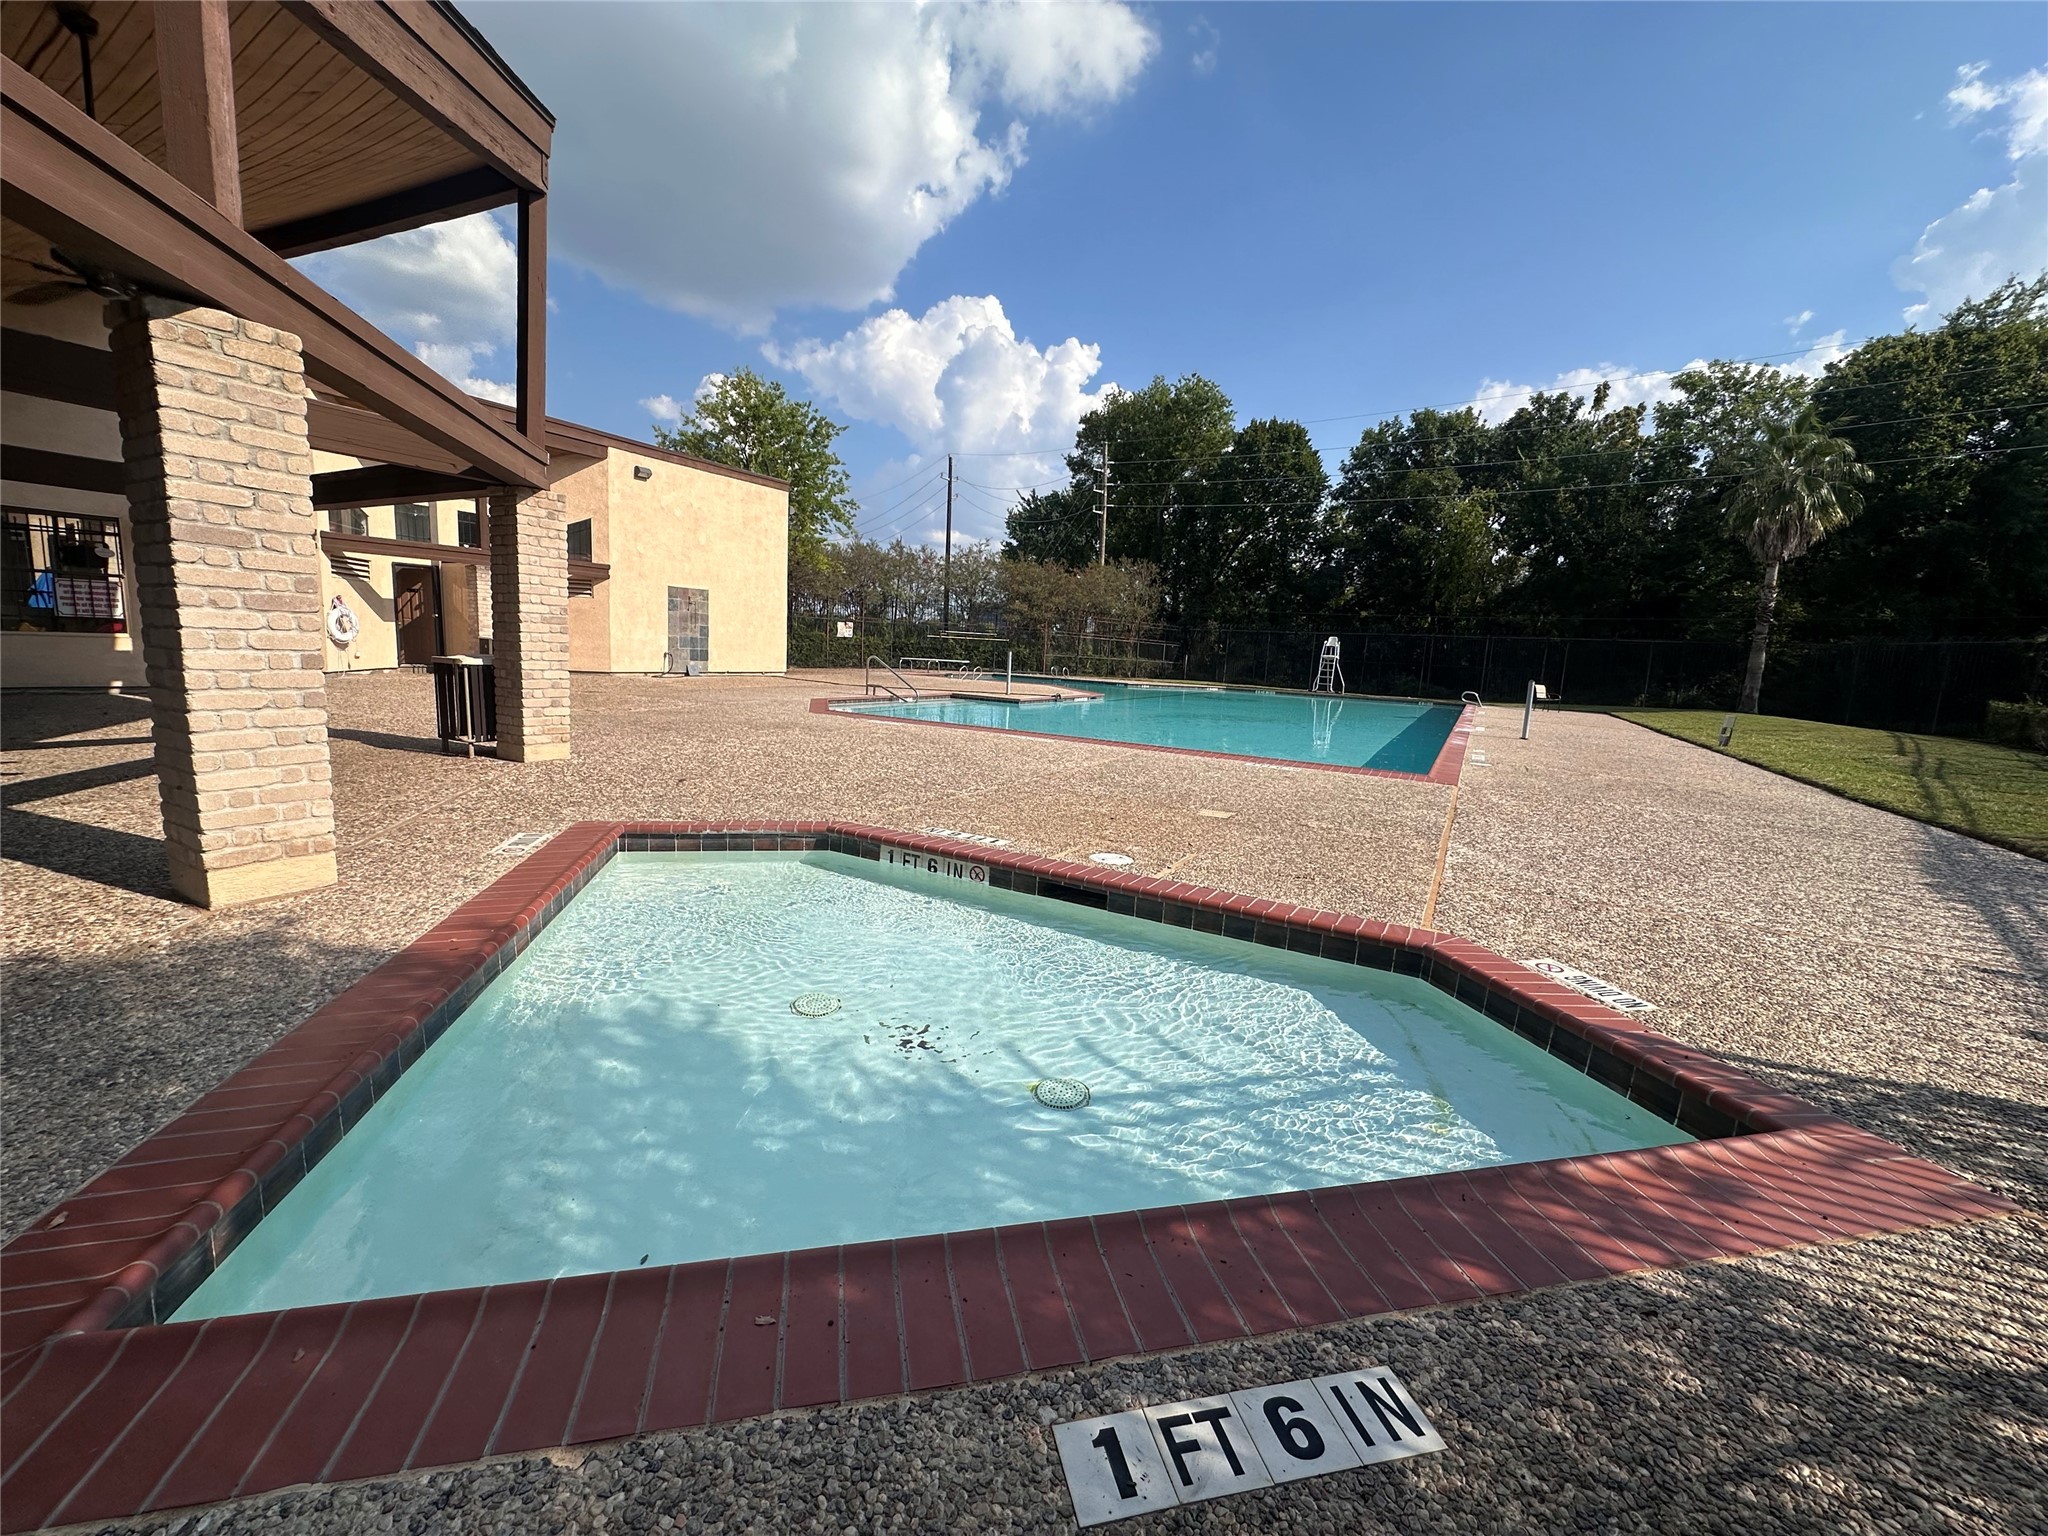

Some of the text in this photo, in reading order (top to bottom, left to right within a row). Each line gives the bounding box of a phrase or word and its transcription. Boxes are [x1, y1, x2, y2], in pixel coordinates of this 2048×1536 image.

[887, 849, 964, 879] 1 FT 6 IN
[1563, 975, 1648, 1009] NO DIVING
[1091, 1376, 1427, 1500] 1 FT 6 IN
